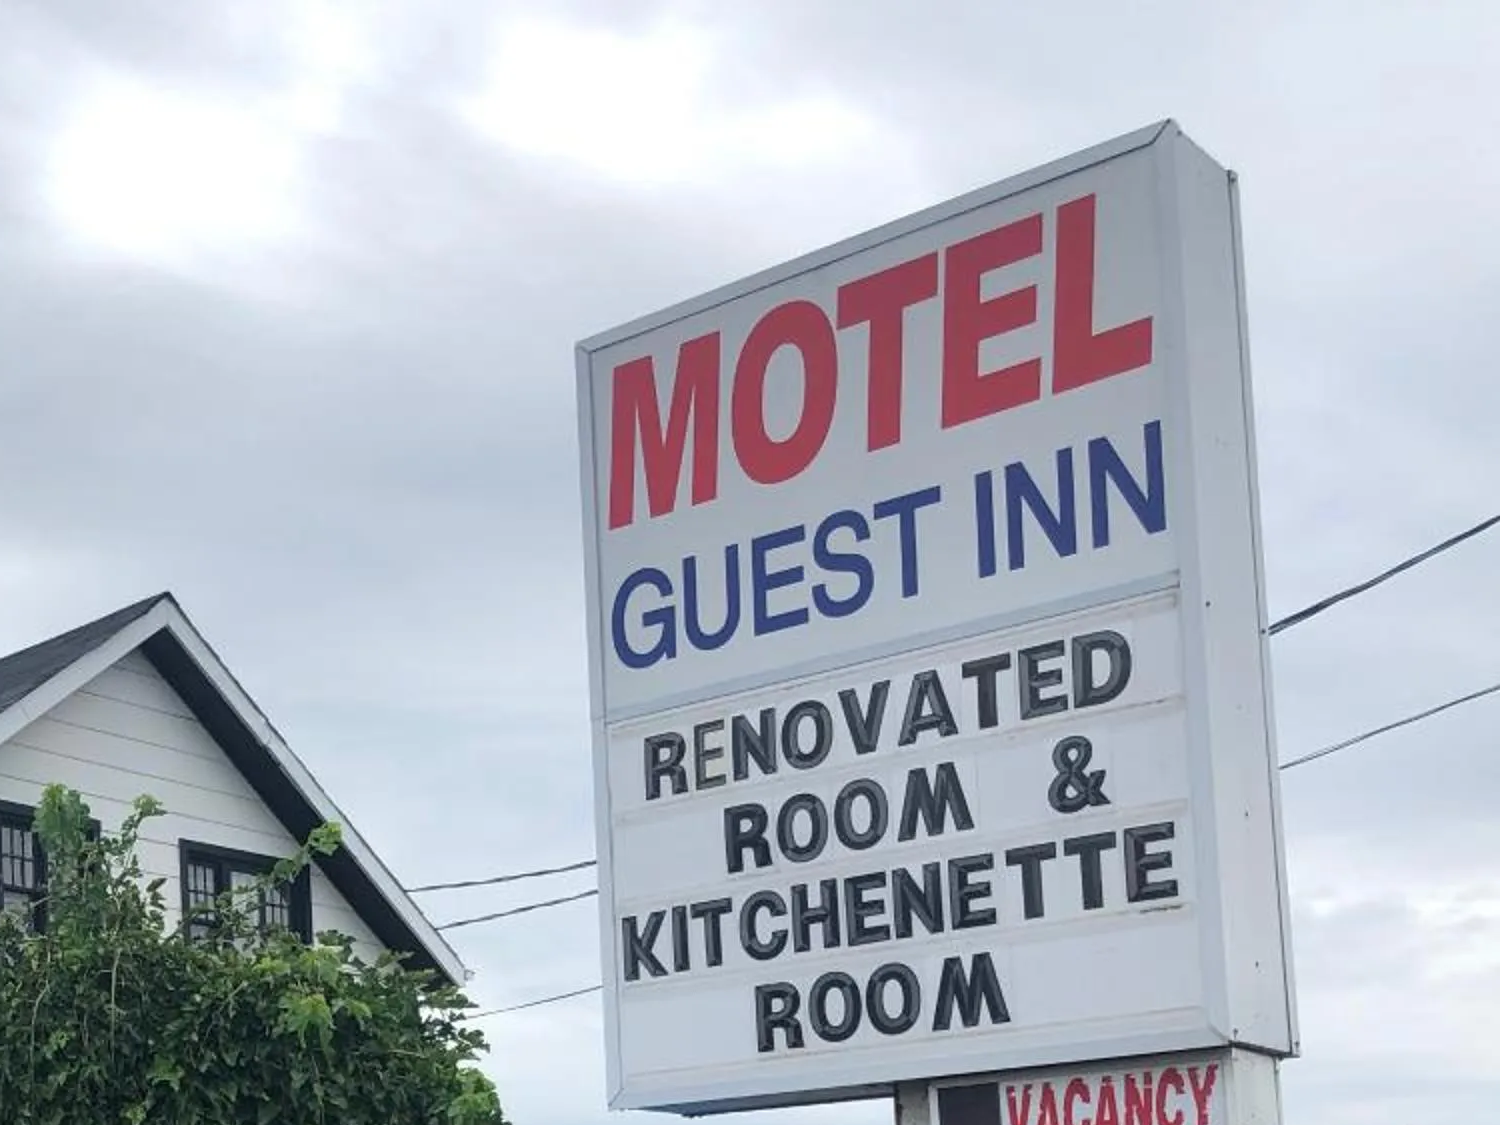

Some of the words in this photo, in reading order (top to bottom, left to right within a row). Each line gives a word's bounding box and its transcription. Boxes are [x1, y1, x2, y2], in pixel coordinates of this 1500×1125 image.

[608, 193, 1153, 530] MOTEL
[612, 486, 941, 669] GUEST
[975, 420, 1168, 578] INN
[644, 629, 1132, 800] RENOVATED
[724, 761, 975, 874] ROOM
[1047, 736, 1110, 814] &
[621, 821, 1179, 981] KITCHENETTE
[755, 951, 1011, 1053] ROOM
